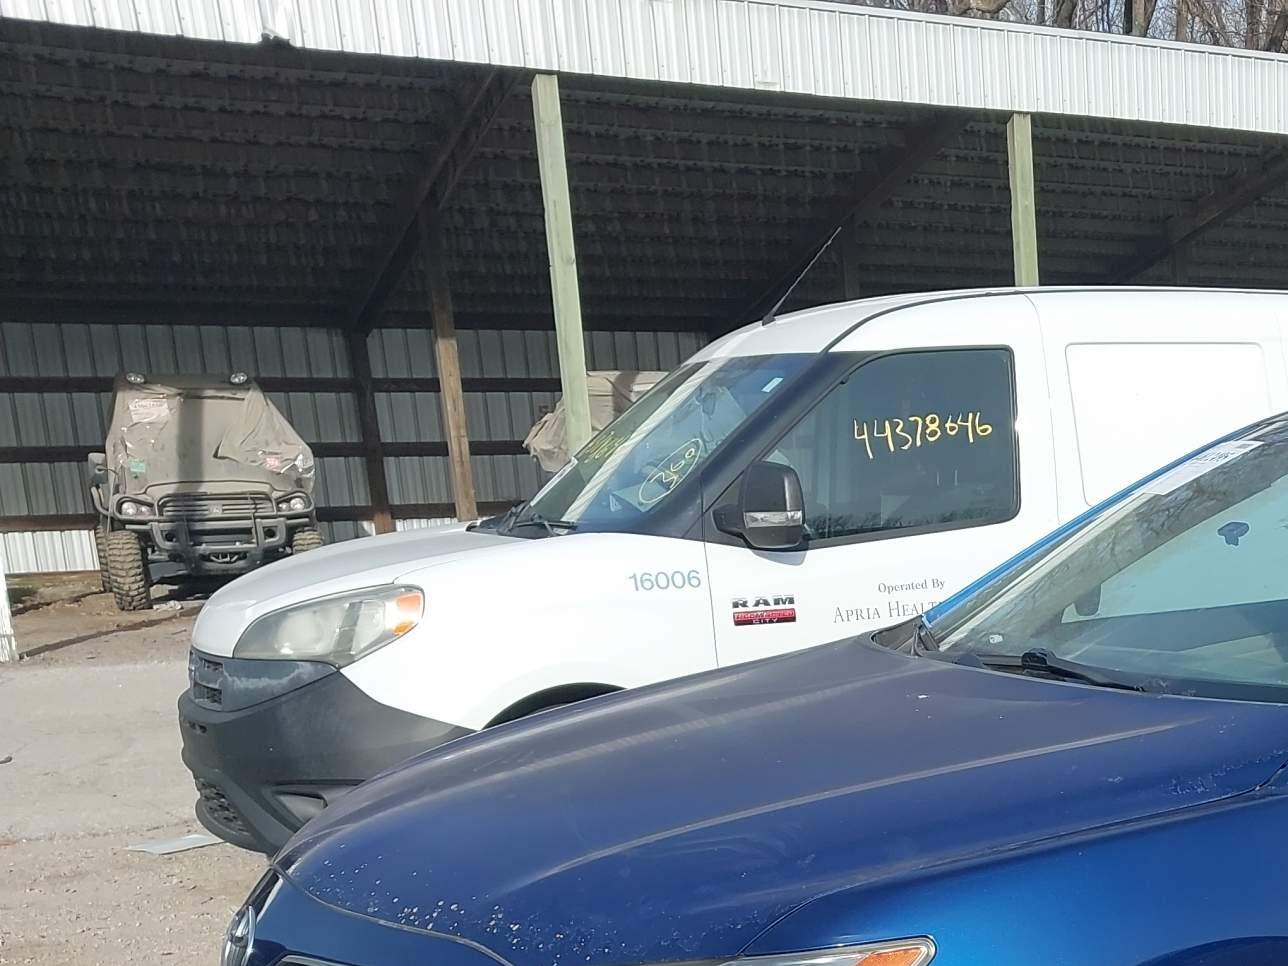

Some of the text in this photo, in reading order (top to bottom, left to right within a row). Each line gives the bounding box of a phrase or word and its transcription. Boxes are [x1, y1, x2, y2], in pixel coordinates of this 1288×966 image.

[853, 411, 993, 460] 44378646
[628, 569, 701, 592] 16006
[878, 578, 945, 594] Operated By
[732, 595, 795, 609] RAM
[833, 606, 881, 623] APRIA
